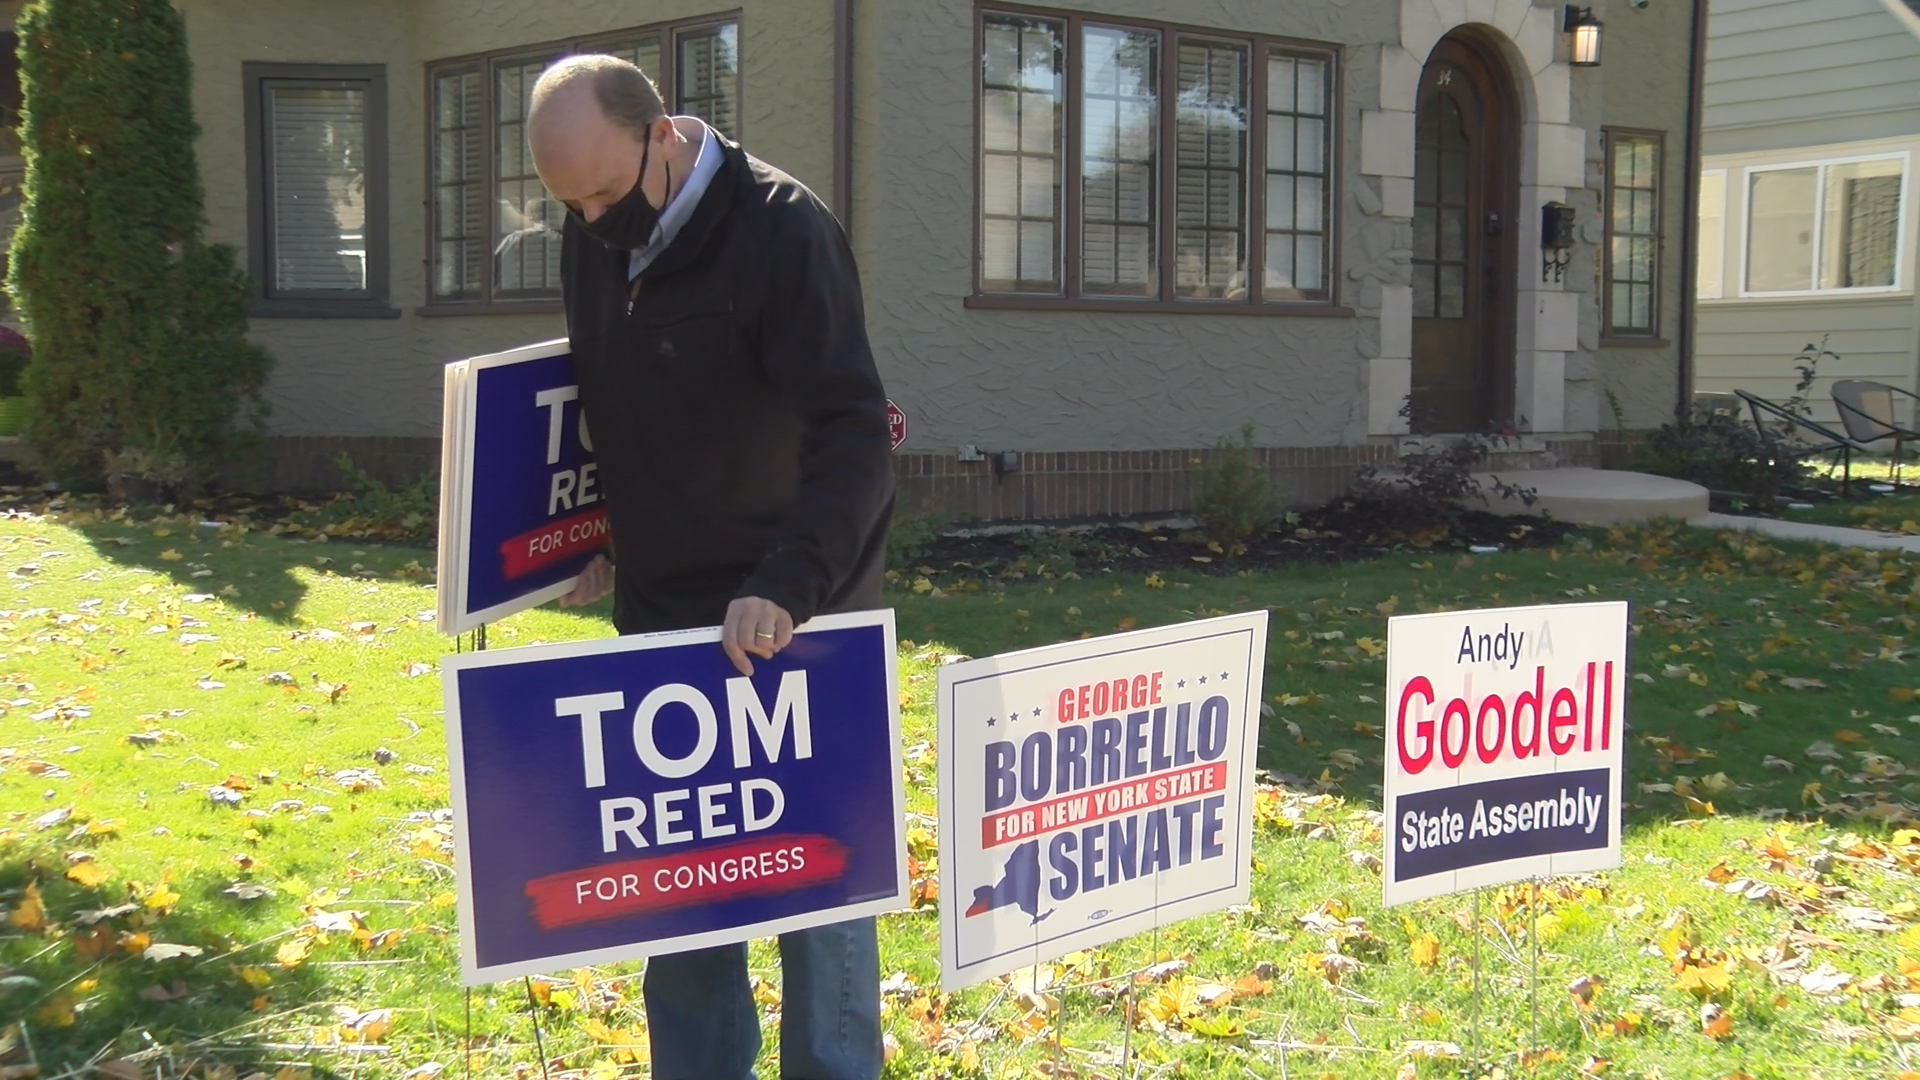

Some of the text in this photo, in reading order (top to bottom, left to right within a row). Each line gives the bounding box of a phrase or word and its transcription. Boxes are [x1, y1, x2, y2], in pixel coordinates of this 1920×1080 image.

[1436, 70, 1452, 85] 34
[548, 462, 606, 516] RE
[528, 516, 611, 558] FOR CON
[1457, 623, 1524, 670] Andy
[555, 669, 813, 788] TOM
[1058, 671, 1164, 723] GEORGE
[1397, 661, 1613, 775] Goodell
[984, 695, 1230, 813] BORRELLO
[600, 778, 785, 853] REED
[995, 767, 1214, 841] FOR NEW YORK STATE
[1401, 787, 1602, 853] State Assembly
[576, 847, 805, 904] FOR CONGRESS
[1049, 794, 1225, 901] SENATE
